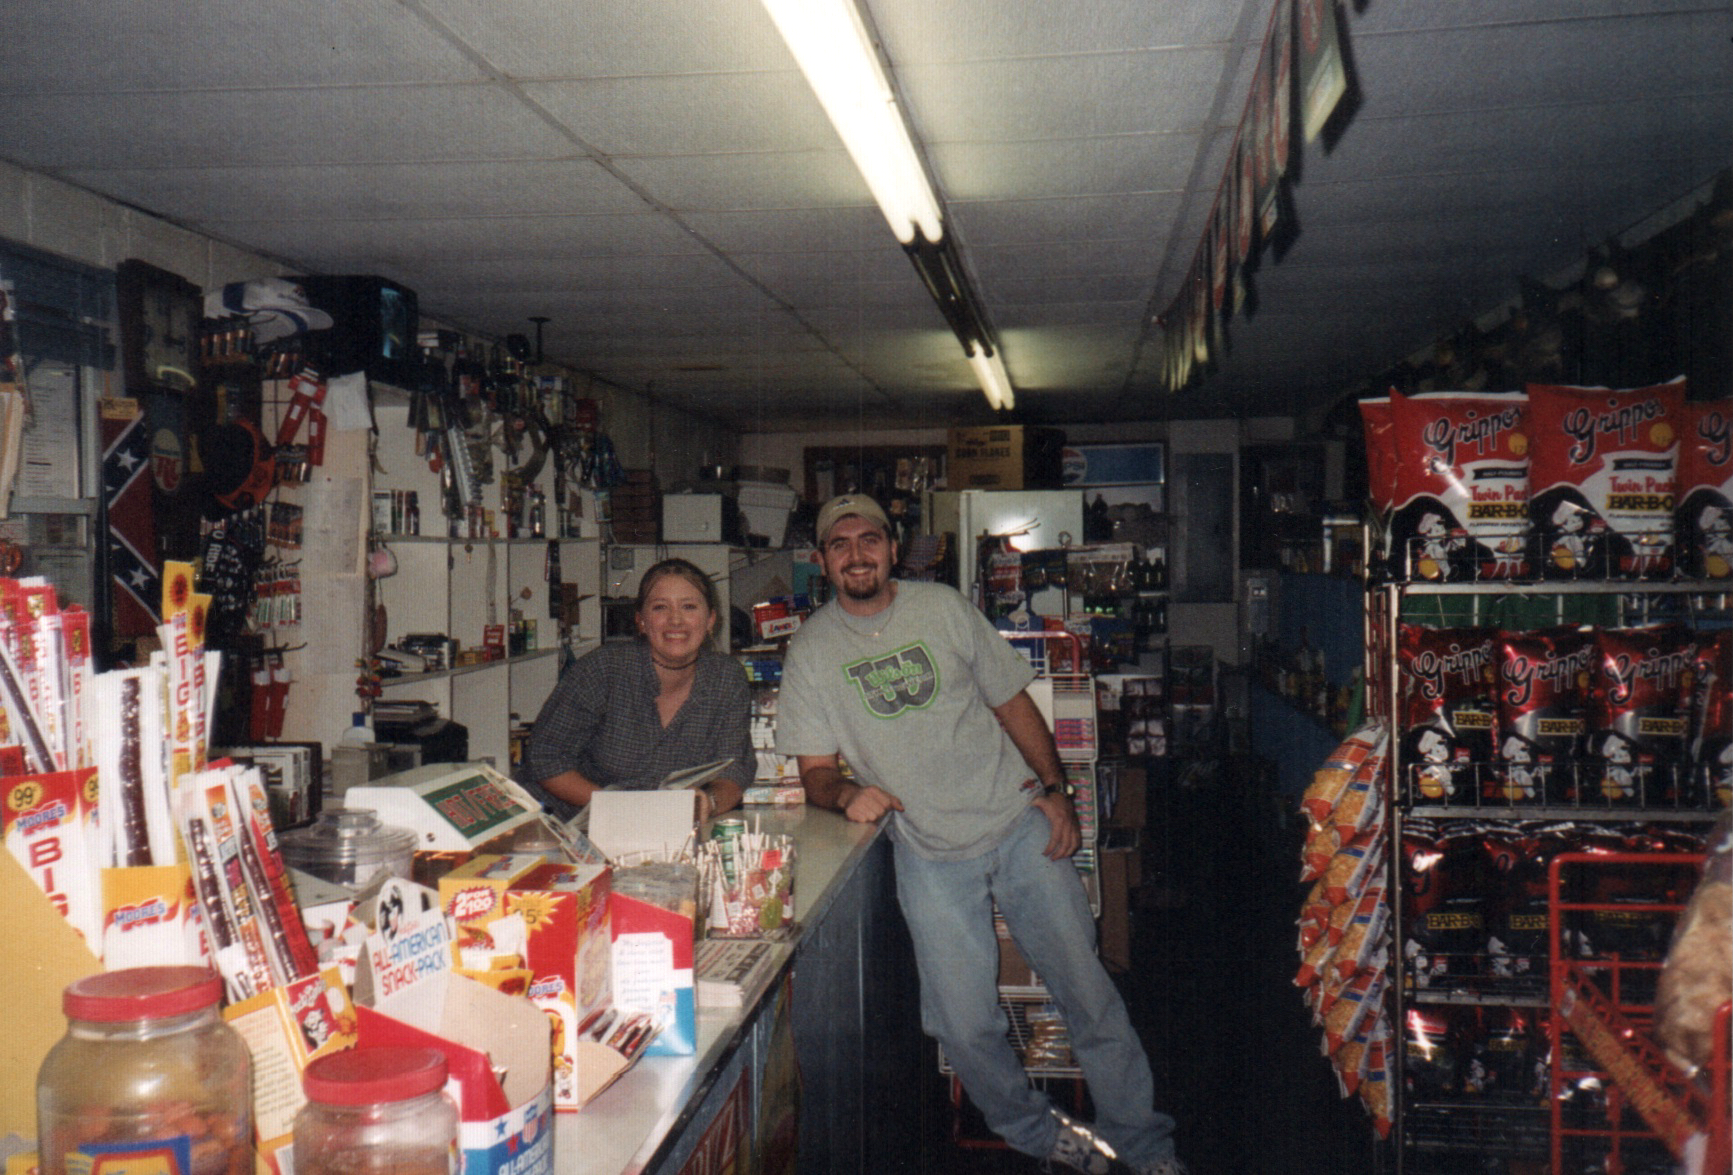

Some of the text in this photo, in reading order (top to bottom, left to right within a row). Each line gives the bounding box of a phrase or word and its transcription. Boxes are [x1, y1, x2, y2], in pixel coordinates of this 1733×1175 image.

[1470, 485, 1502, 502] Twin
[1609, 476, 1642, 493] Twin
[373, 921, 447, 976] ALL-AMERICAN
[381, 946, 446, 996] SNACK-PACK
